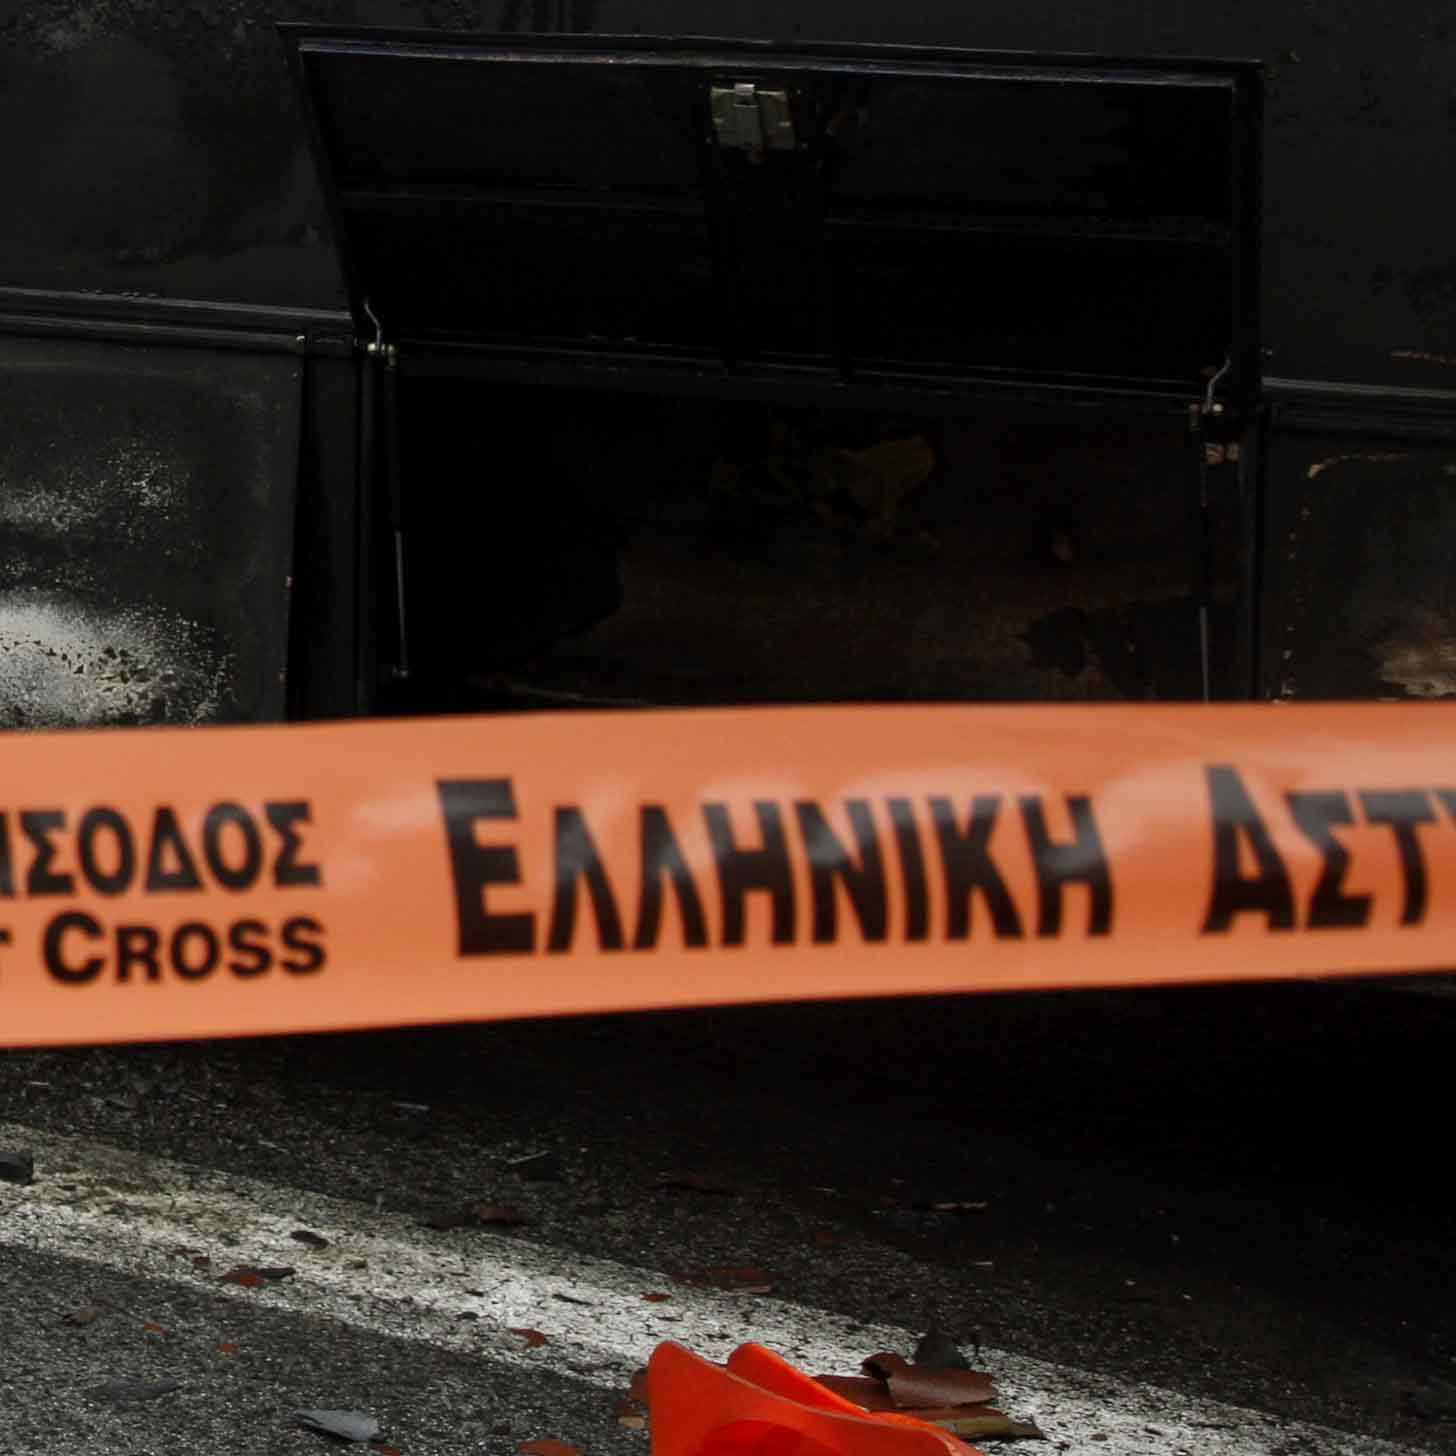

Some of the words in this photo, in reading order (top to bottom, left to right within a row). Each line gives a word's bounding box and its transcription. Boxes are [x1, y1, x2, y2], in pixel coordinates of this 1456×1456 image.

[436, 778, 1115, 958] ΕΛΛΗΝΙΚΗ
[1200, 765, 1455, 935] ΑΣΤ
[42, 910, 326, 986] CROSS
